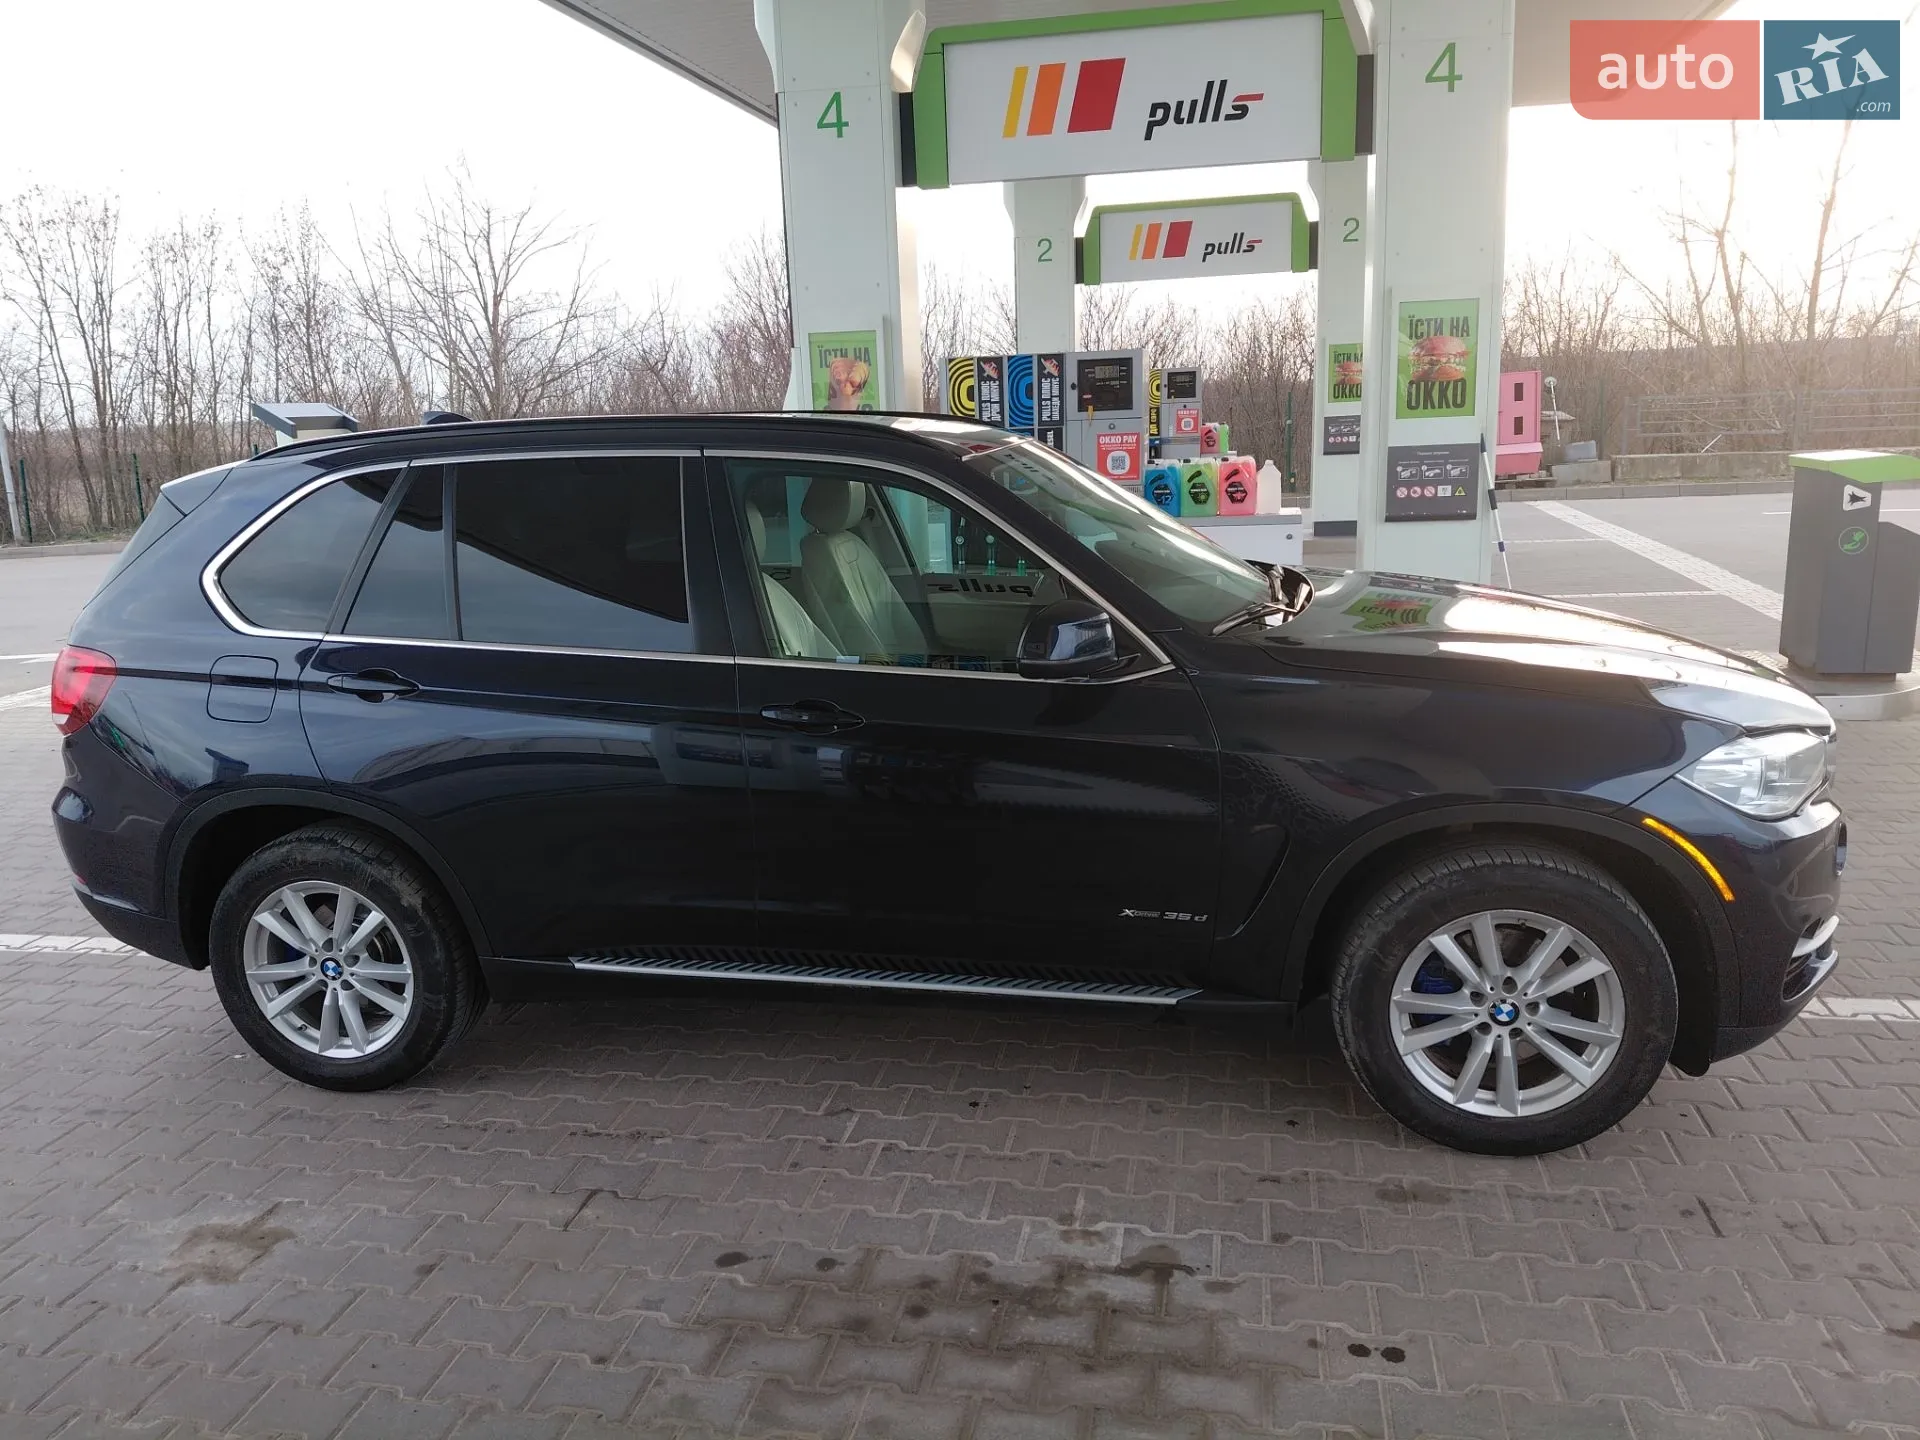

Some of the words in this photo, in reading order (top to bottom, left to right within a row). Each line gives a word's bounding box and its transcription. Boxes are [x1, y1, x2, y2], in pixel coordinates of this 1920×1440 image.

[1425, 42, 1463, 92] 4
[817, 91, 849, 138] 4
[1143, 79, 1264, 141] pulls
[1343, 217, 1360, 243] 2
[1037, 238, 1053, 262] 2
[1202, 232, 1262, 263] pulls
[1408, 314, 1444, 340] ЇСТИ
[1449, 316, 1470, 338] НА
[1041, 400, 1051, 421] PULLS
[1099, 435, 1121, 444] OKKO
[1123, 435, 1137, 443] PAY
